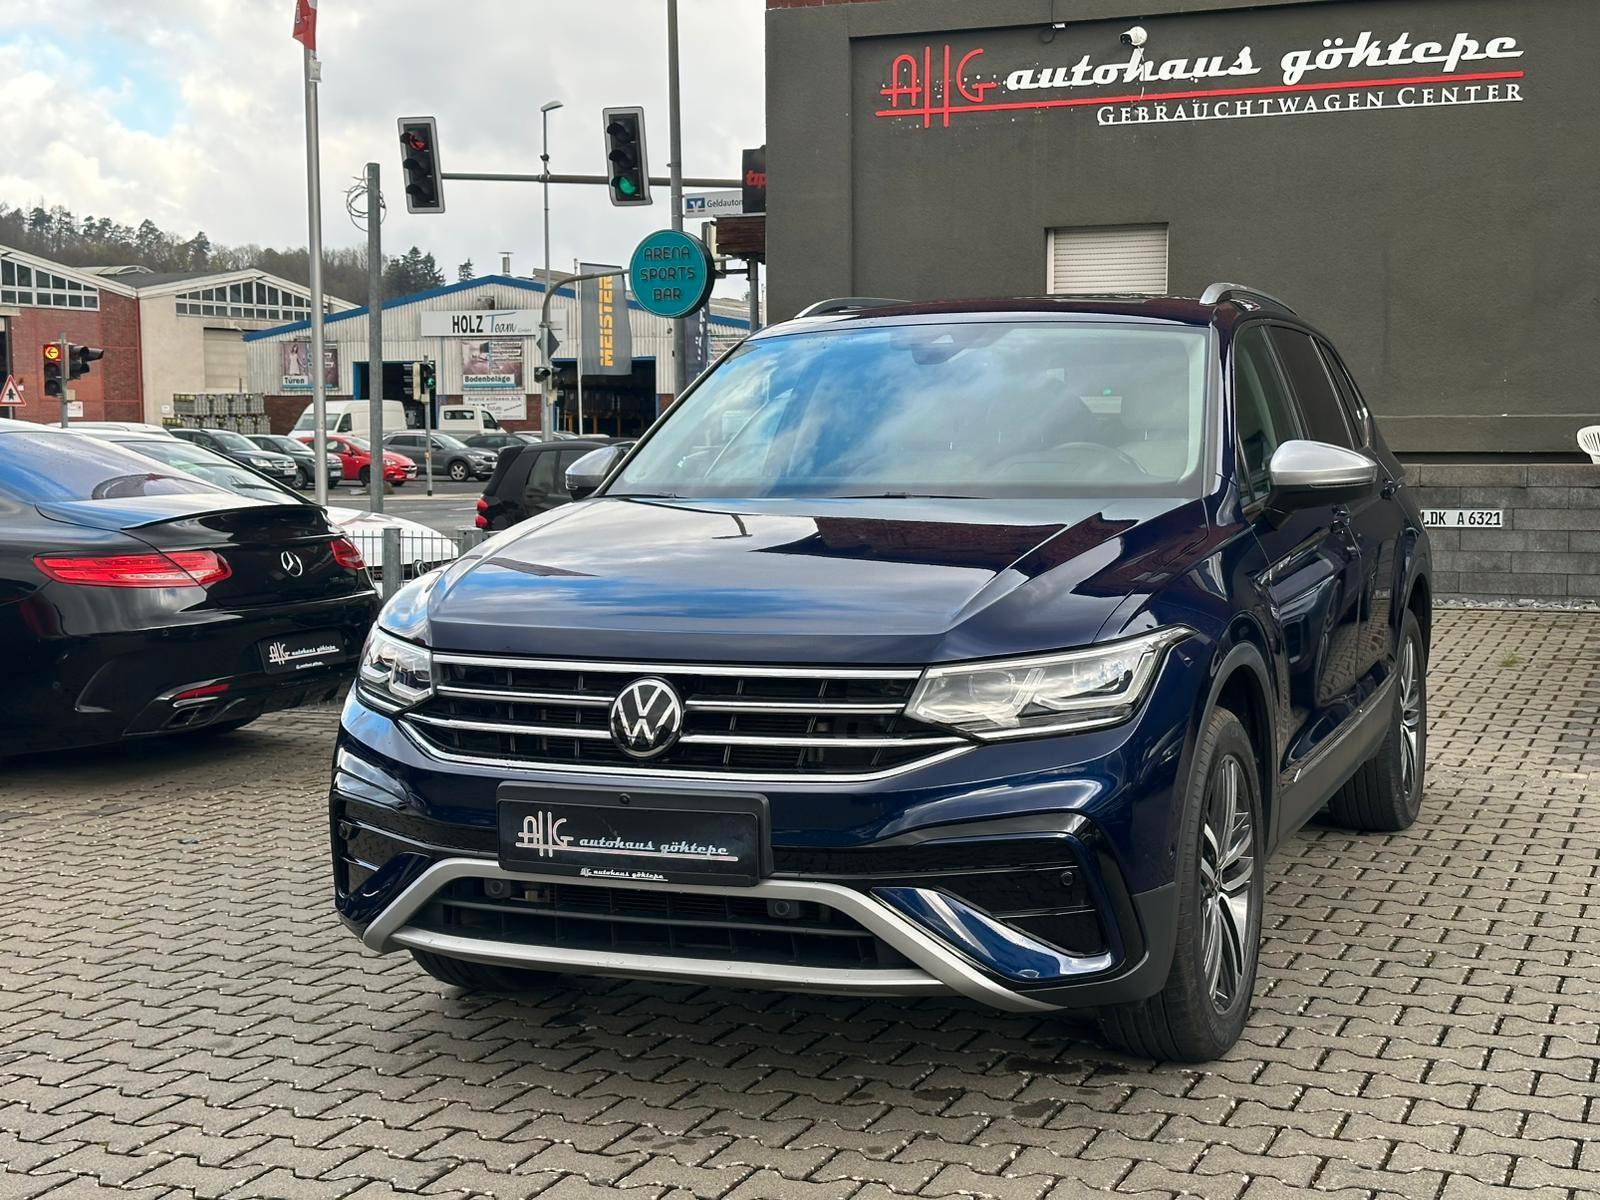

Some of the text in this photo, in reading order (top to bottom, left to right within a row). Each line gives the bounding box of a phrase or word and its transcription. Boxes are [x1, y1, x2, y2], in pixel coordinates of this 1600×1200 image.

[1006, 47, 1262, 91] autohaus
[1280, 31, 1525, 86] göktepe
[1397, 83, 1524, 106] CENTER
[644, 246, 690, 260] ARENA
[640, 265, 696, 281] SPORTS
[653, 287, 682, 301] BAR
[452, 312, 517, 333] HOLZ Team
[598, 275, 614, 367] MEISTER
[1422, 511, 1501, 526] LDK A 6321
[579, 836, 655, 851] autohaus
[660, 841, 729, 857] göktepe
